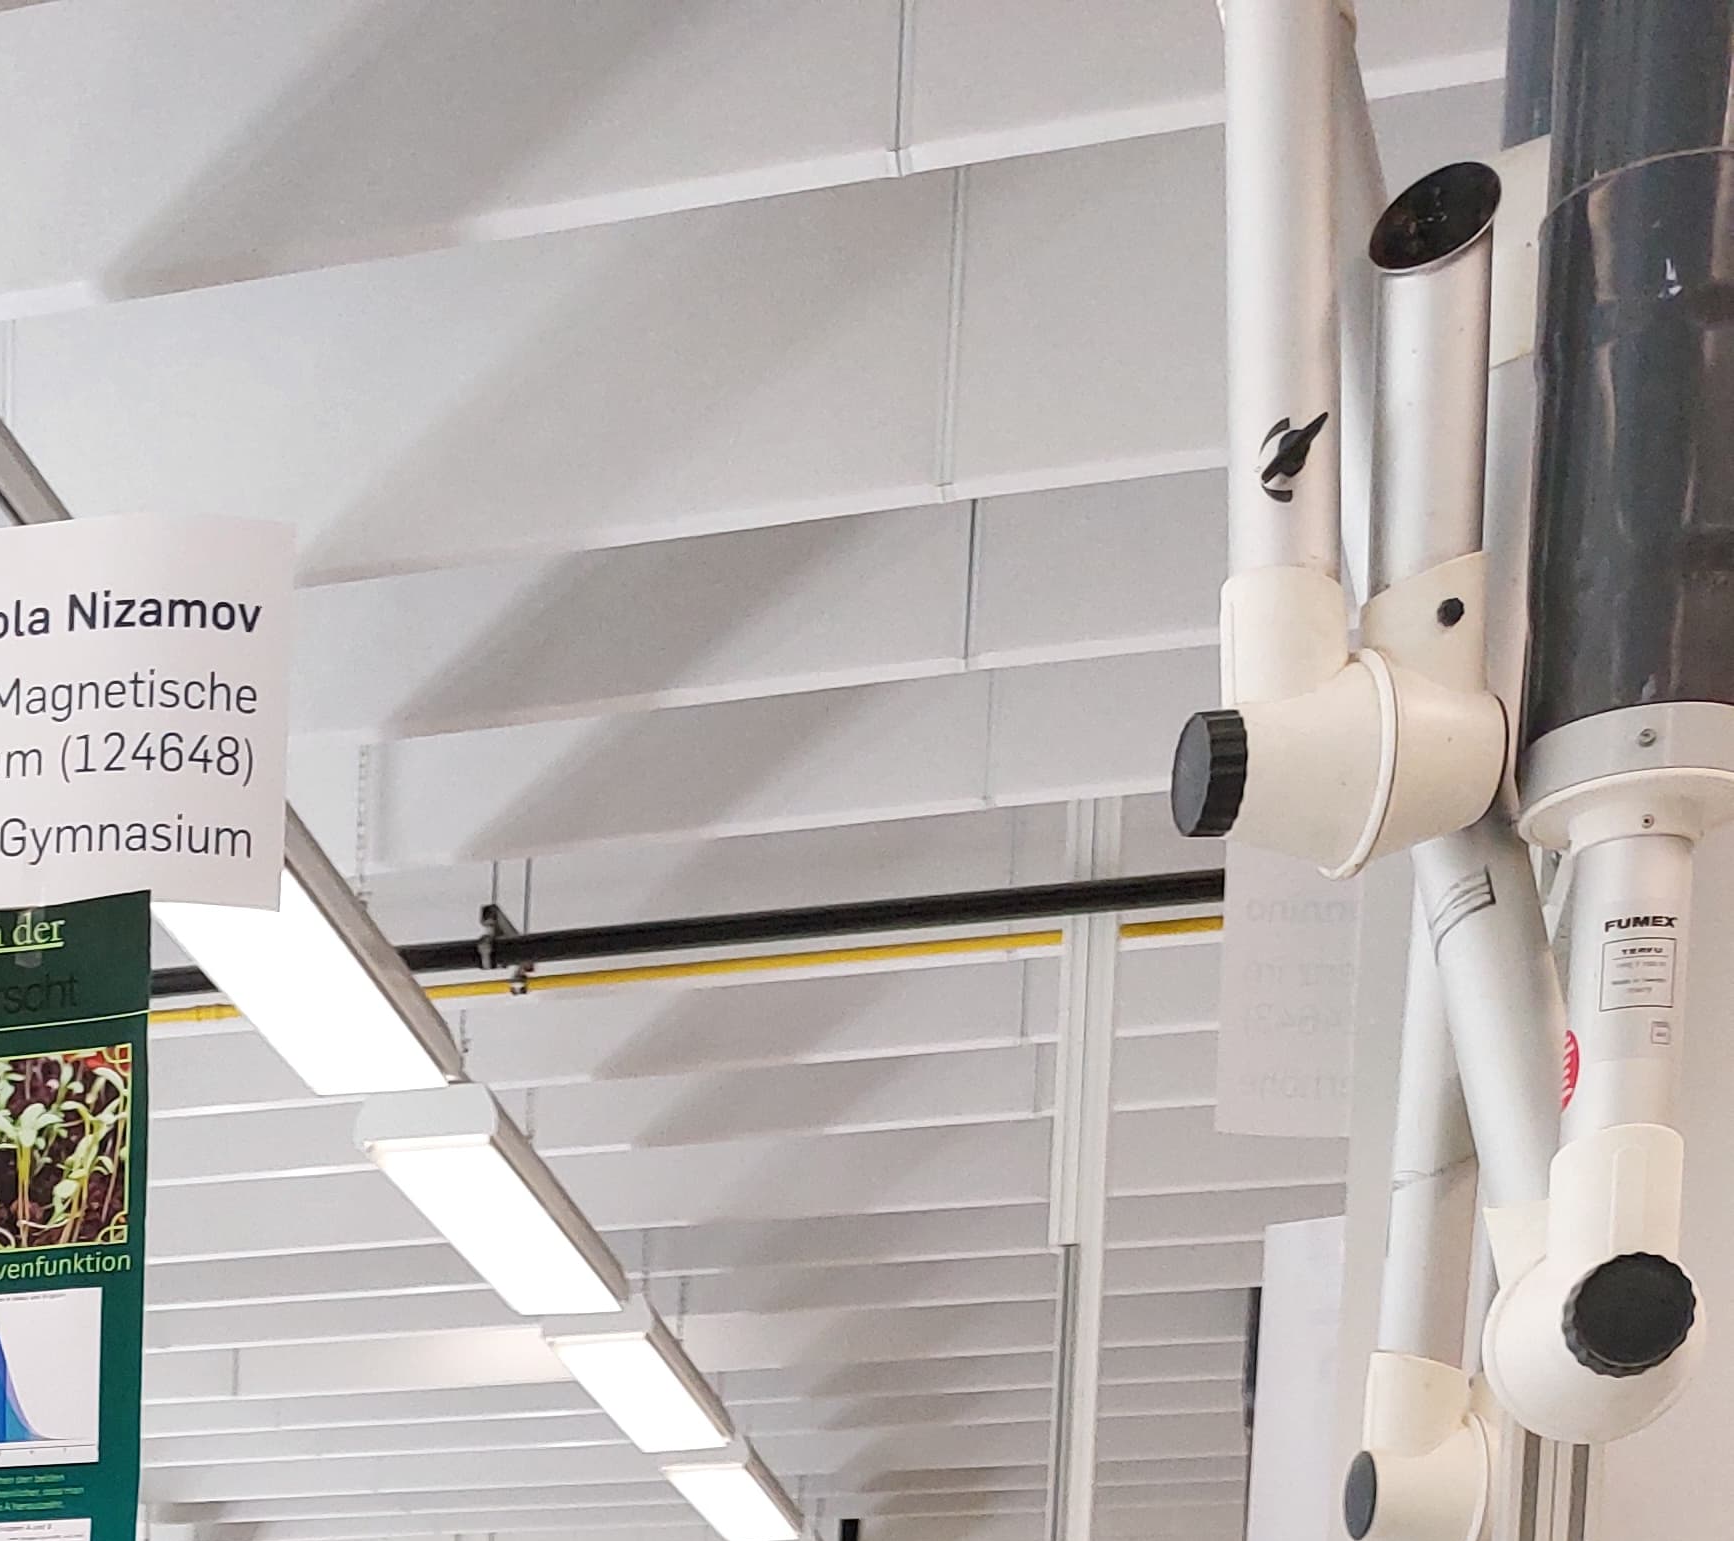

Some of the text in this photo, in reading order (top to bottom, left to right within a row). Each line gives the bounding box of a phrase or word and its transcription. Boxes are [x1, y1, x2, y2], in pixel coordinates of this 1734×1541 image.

[68, 591, 262, 634] Nizamov
[60, 731, 255, 787] (124648)
[12, 912, 64, 945] der
[1605, 916, 1678, 932] FUMEX
